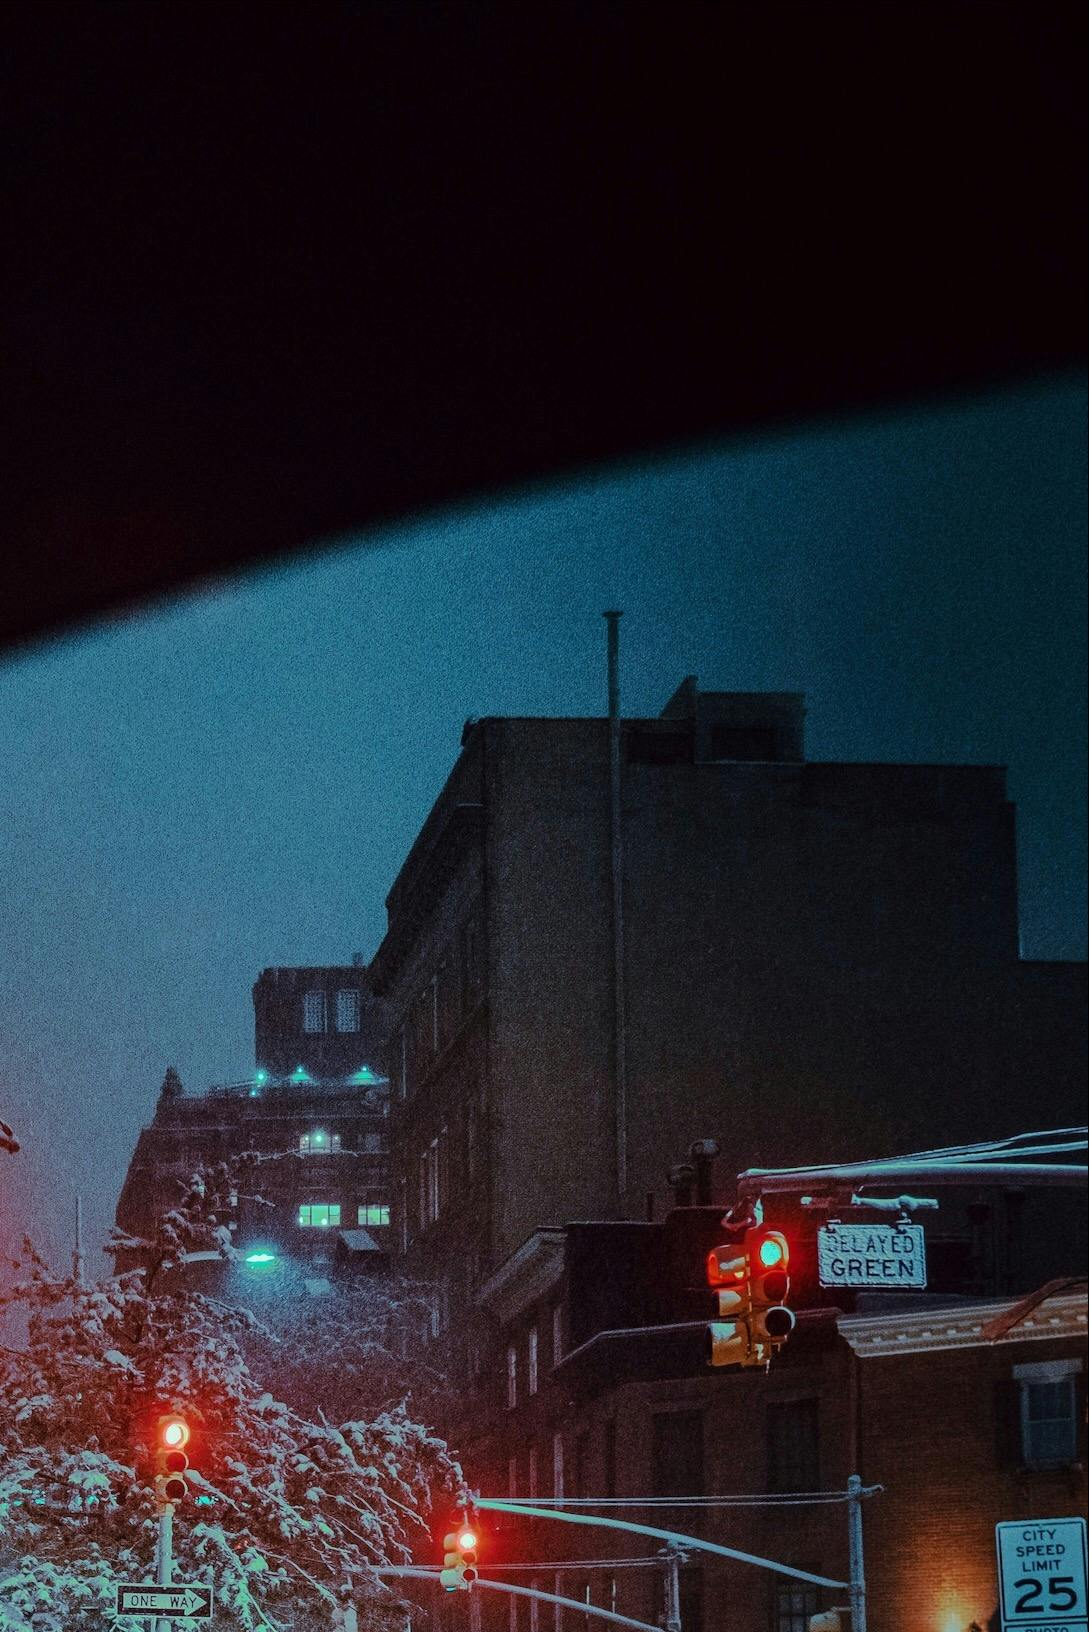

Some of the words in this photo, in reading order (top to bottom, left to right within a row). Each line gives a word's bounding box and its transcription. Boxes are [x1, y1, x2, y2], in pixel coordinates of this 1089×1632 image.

[826, 1235, 914, 1254] DELAYED
[830, 1258, 914, 1277] GREEN
[1022, 1529, 1056, 1541] CITY
[1016, 1544, 1066, 1557] SPEED
[1022, 1559, 1061, 1573] LIMIT
[130, 1595, 157, 1607] ONE
[170, 1596, 197, 1608] WAY
[1014, 1576, 1078, 1614] 25
